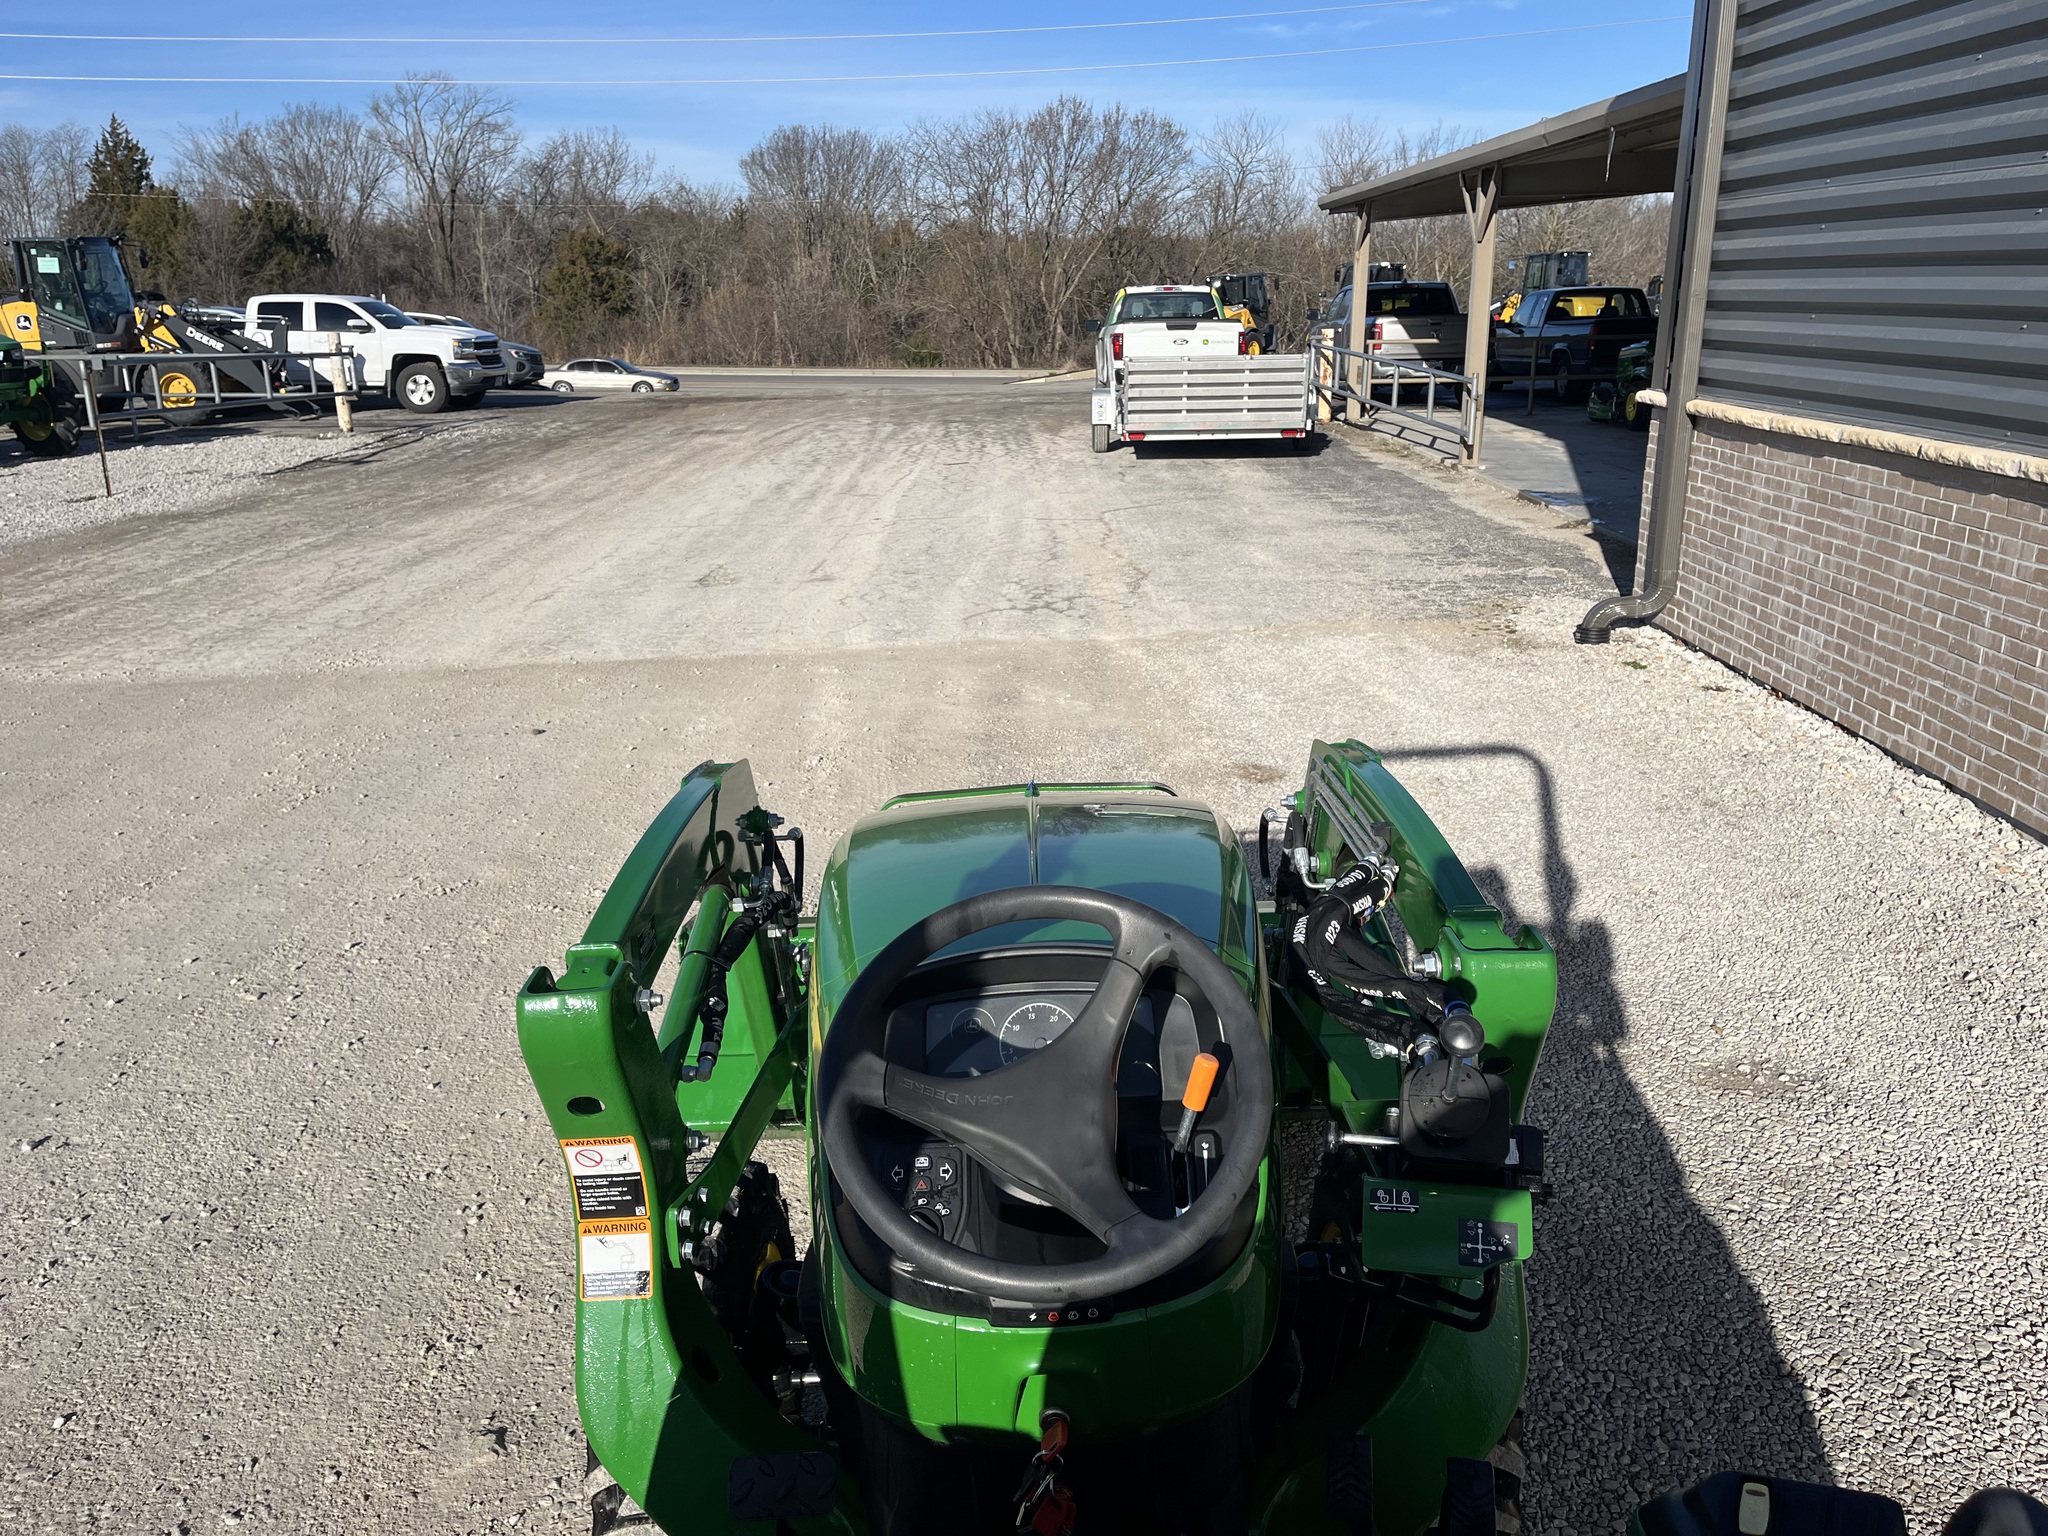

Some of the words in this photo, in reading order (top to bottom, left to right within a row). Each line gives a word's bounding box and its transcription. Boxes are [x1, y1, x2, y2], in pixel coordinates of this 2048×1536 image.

[186, 326, 225, 352] DEERE
[1352, 895, 1372, 915] MSHA
[1293, 915, 1309, 944] MSHA
[1325, 920, 1340, 945] D23
[1012, 1024, 1020, 1032] 10
[901, 1078, 960, 1106] DEERE
[573, 1137, 631, 1146] WARNING
[593, 1222, 647, 1233] WARNING
